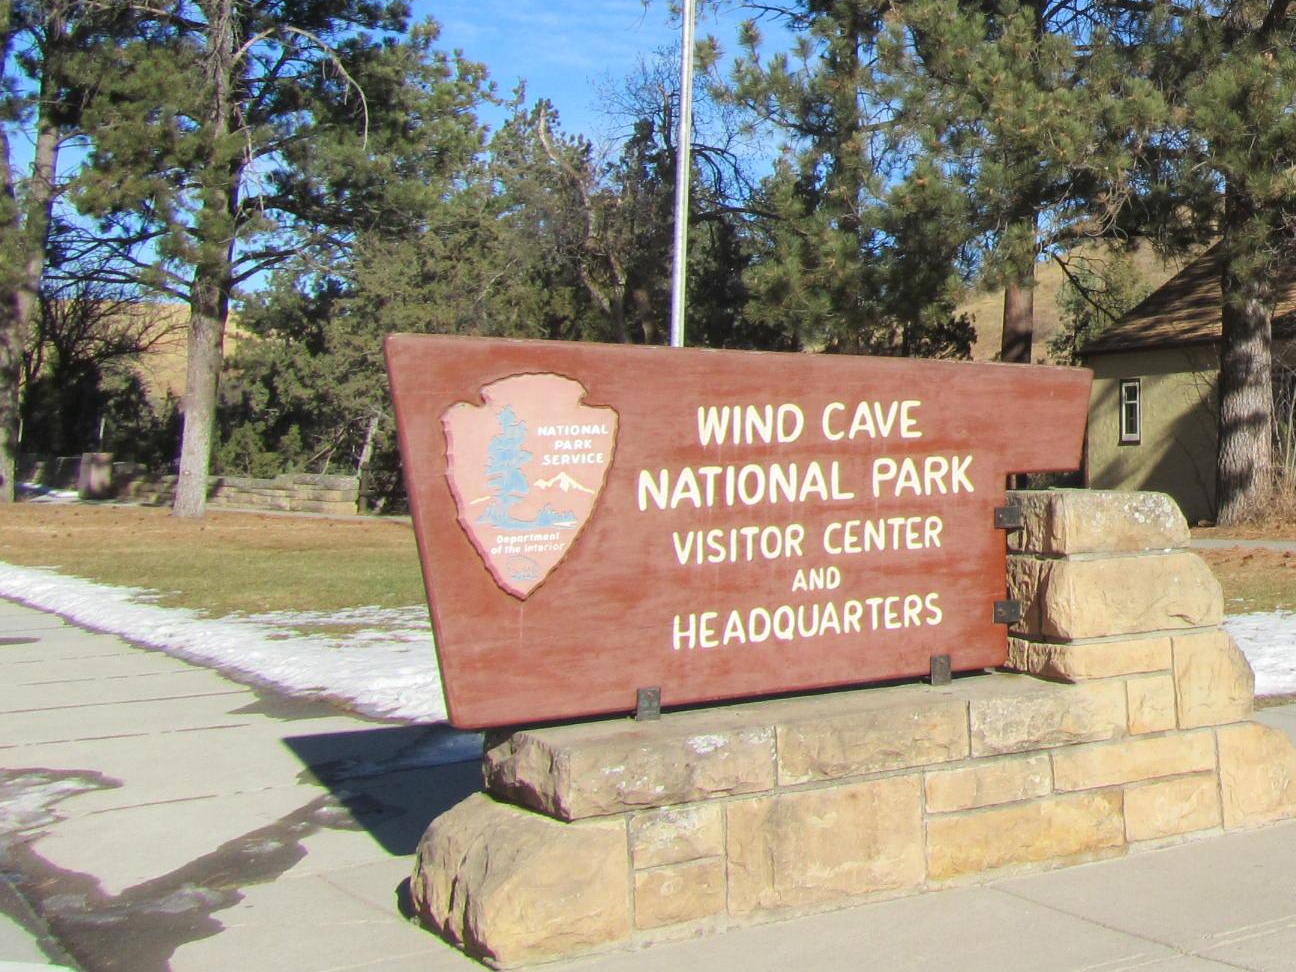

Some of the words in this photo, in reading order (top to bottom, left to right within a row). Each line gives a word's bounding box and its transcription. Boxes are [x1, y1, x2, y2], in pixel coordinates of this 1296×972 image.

[537, 425, 609, 437] NATIONAL
[697, 403, 805, 447] WIND
[821, 399, 923, 442] CAVE
[554, 439, 593, 450] PARK
[542, 453, 604, 466] SERVICE
[636, 460, 855, 512] NATIONAL
[872, 455, 975, 499] PARK
[496, 532, 560, 544] Department
[671, 522, 804, 566] VISITOR
[823, 515, 943, 555] CENTER
[490, 544, 503, 555] of
[504, 544, 521, 554] the
[791, 565, 842, 593] AND
[671, 594, 943, 651] HEADQUARTERS
